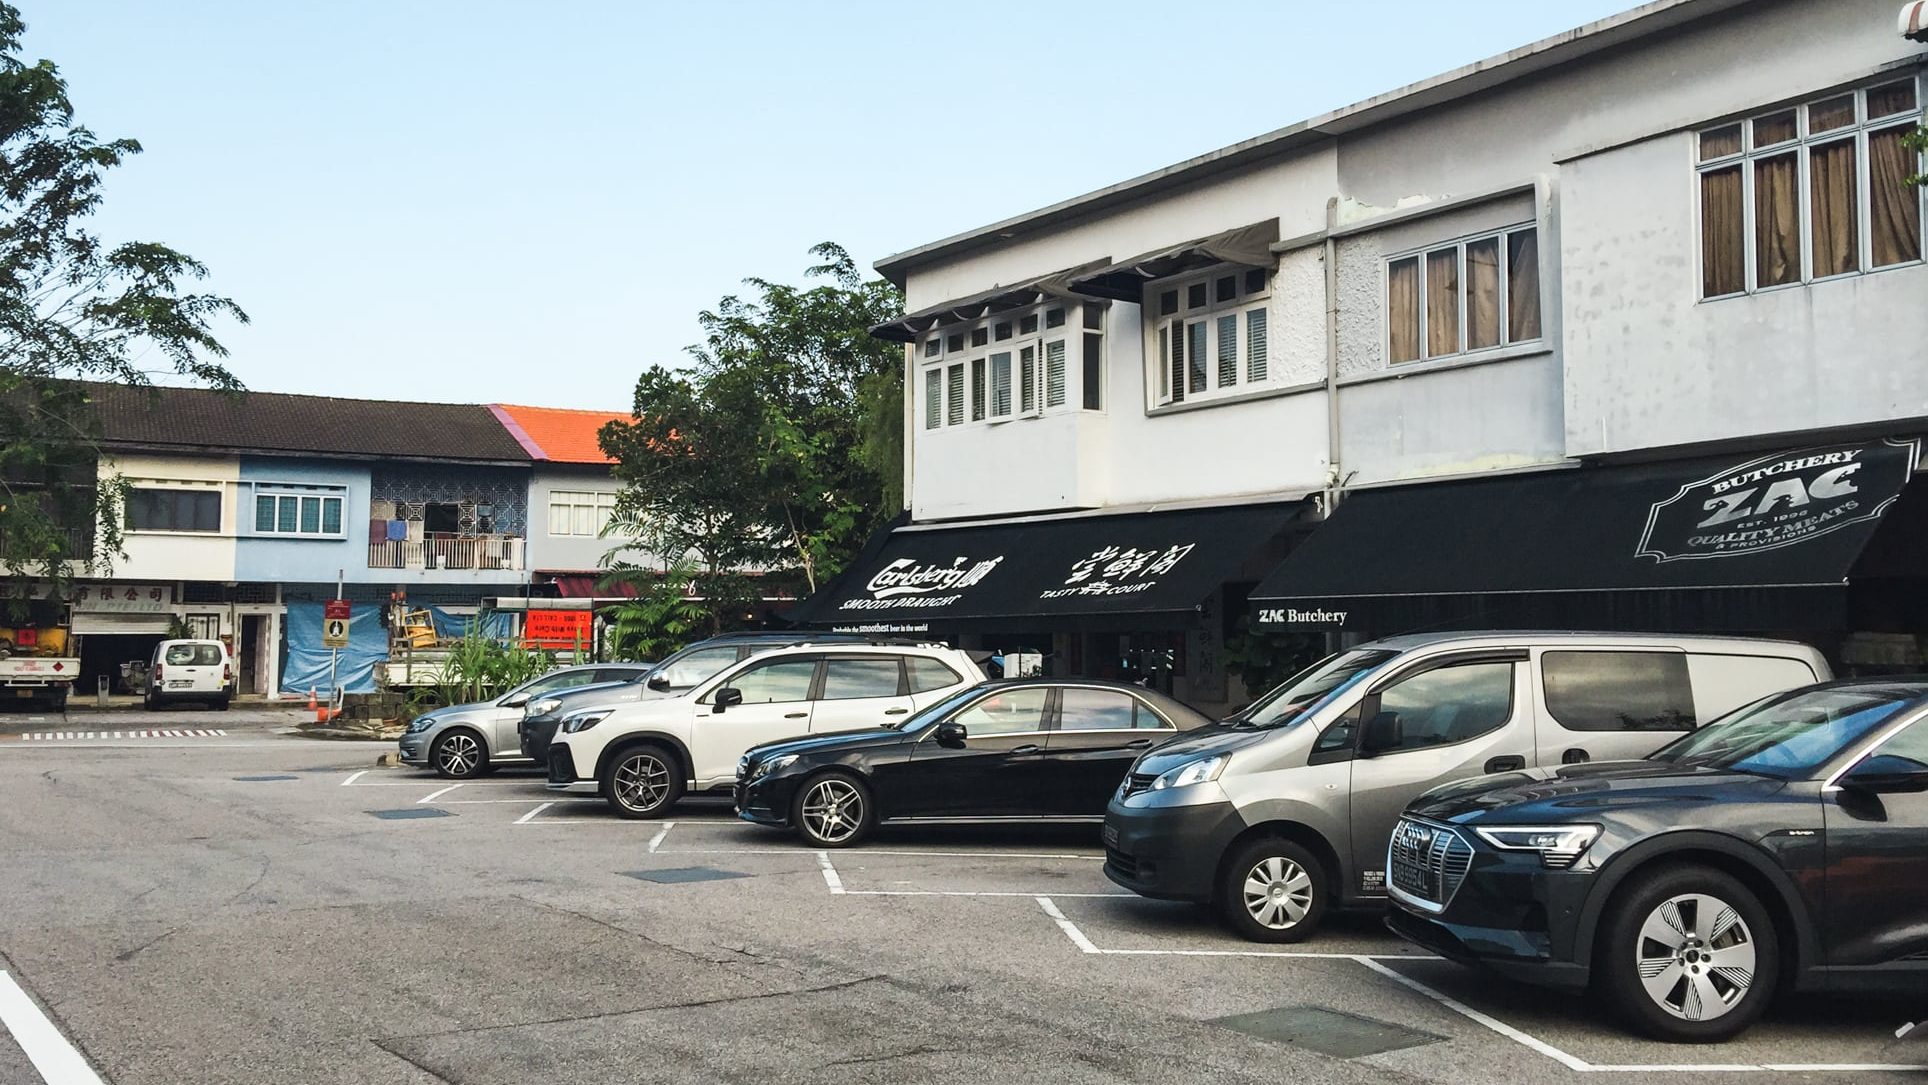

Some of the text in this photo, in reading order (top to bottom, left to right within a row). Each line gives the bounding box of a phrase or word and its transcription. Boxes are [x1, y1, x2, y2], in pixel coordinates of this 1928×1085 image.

[1712, 449, 1863, 494] BUTCHERY
[1697, 462, 1862, 529] ZAC
[1687, 500, 1860, 547] QUALITY MEATS
[1729, 525, 1818, 548] PROVISIONS
[867, 557, 969, 594] Carlsberg
[1039, 581, 1157, 599] TASTY COURT
[839, 594, 962, 610] SMOOTH DRAUGHT
[859, 622, 889, 633] smoothest
[890, 624, 900, 632] beer
[914, 623, 928, 632] world
[1259, 608, 1348, 626] ZAC Butchery
